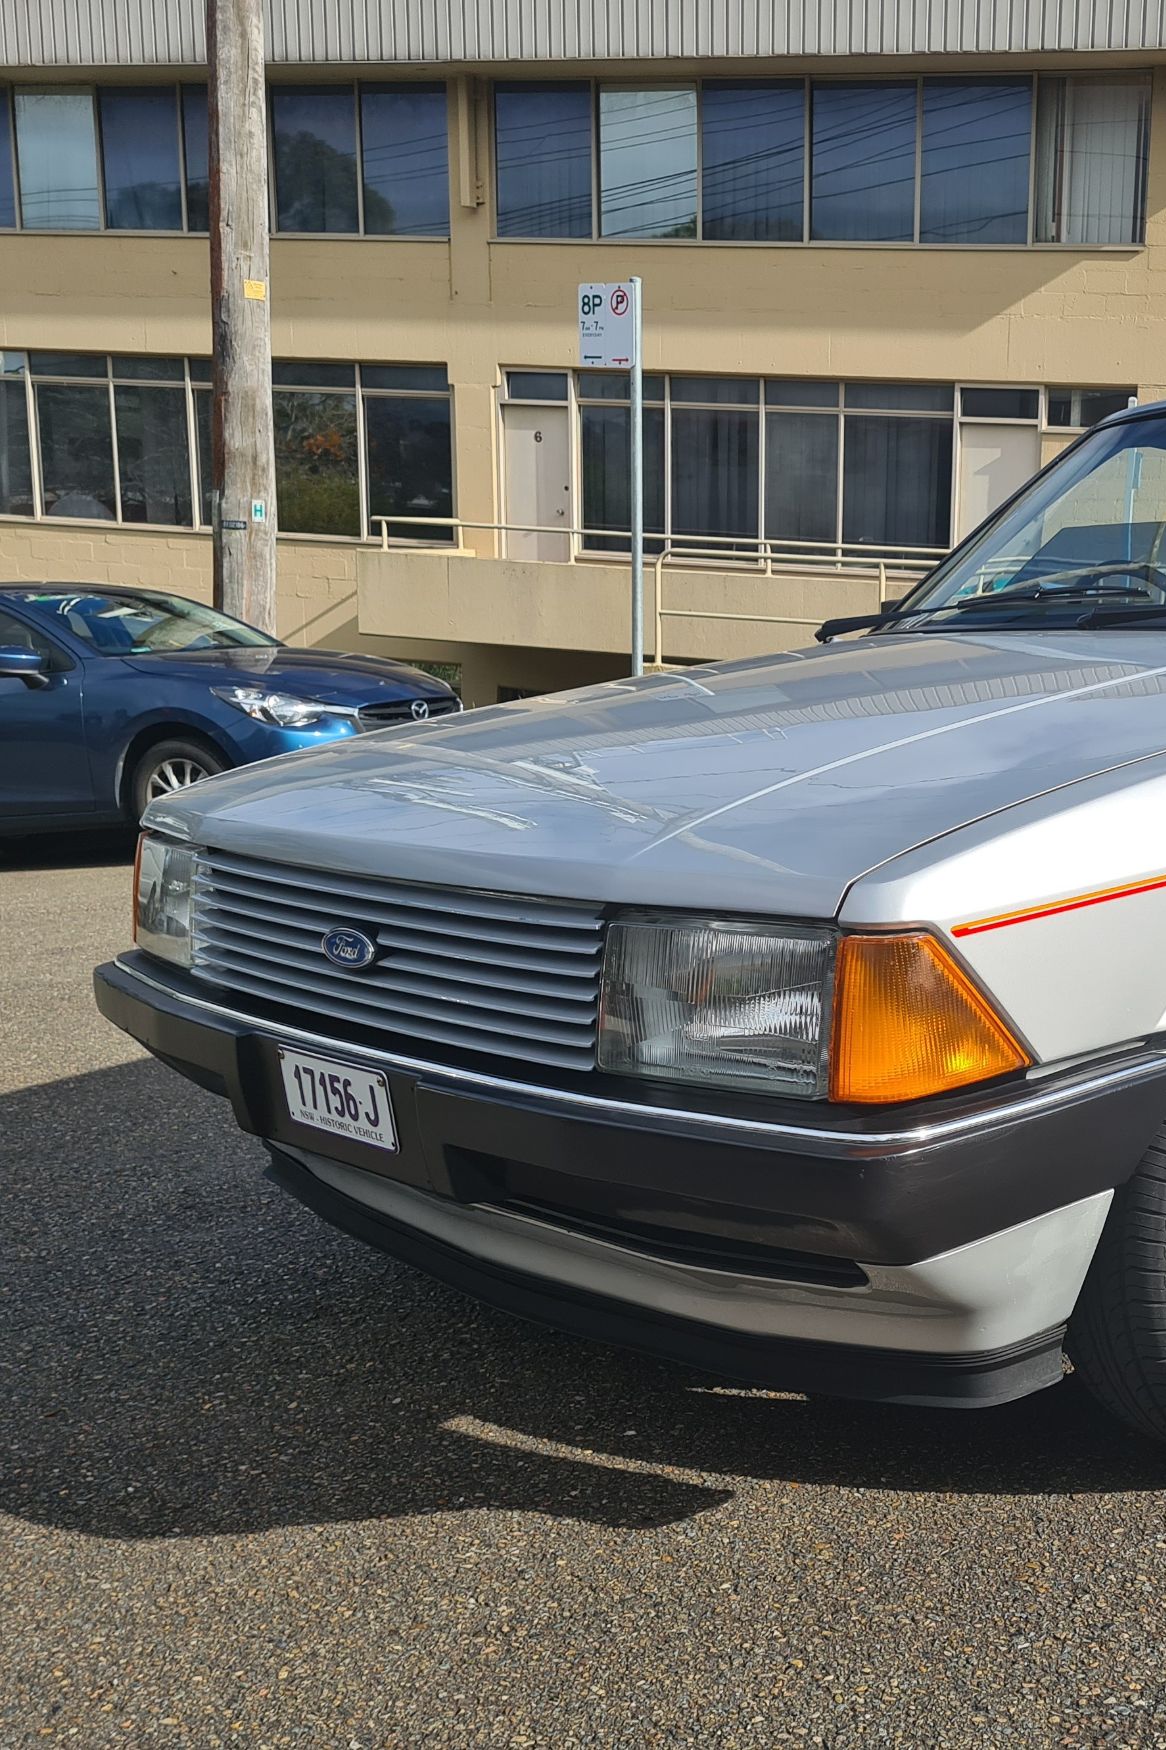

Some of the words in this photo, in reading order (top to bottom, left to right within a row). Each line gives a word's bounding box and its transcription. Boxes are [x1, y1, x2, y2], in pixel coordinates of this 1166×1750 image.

[581, 294, 603, 316] 8P
[534, 430, 543, 443] 6
[253, 503, 263, 518] H
[332, 934, 361, 961] Ford
[293, 1063, 360, 1122] 17156
[319, 1114, 353, 1133] HISTORIC
[353, 1124, 385, 1143] VEHICLE
